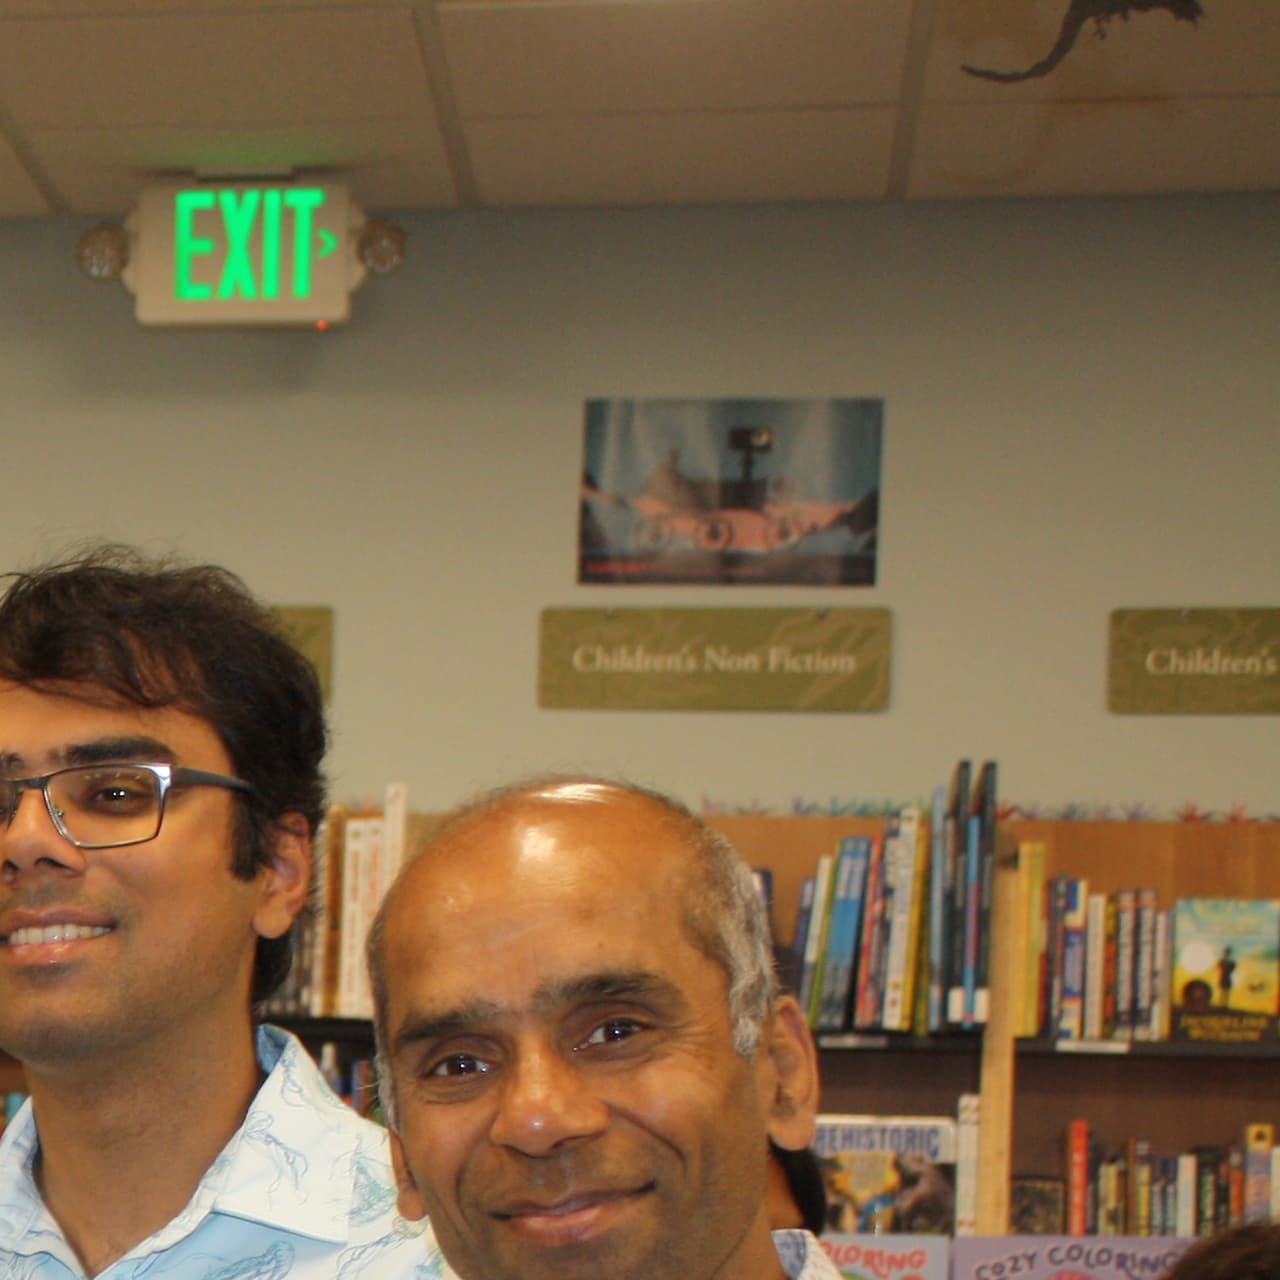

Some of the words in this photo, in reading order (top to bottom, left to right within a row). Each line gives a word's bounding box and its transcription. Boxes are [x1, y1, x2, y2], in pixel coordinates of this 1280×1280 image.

[175, 187, 325, 300] EXIT
[572, 644, 698, 673] Children's
[704, 646, 760, 673] Non
[768, 645, 857, 673] Fiction
[1144, 645, 1279, 675] Children's
[812, 1125, 940, 1159] REHISTORIC
[818, 1239, 928, 1280] OLORING
